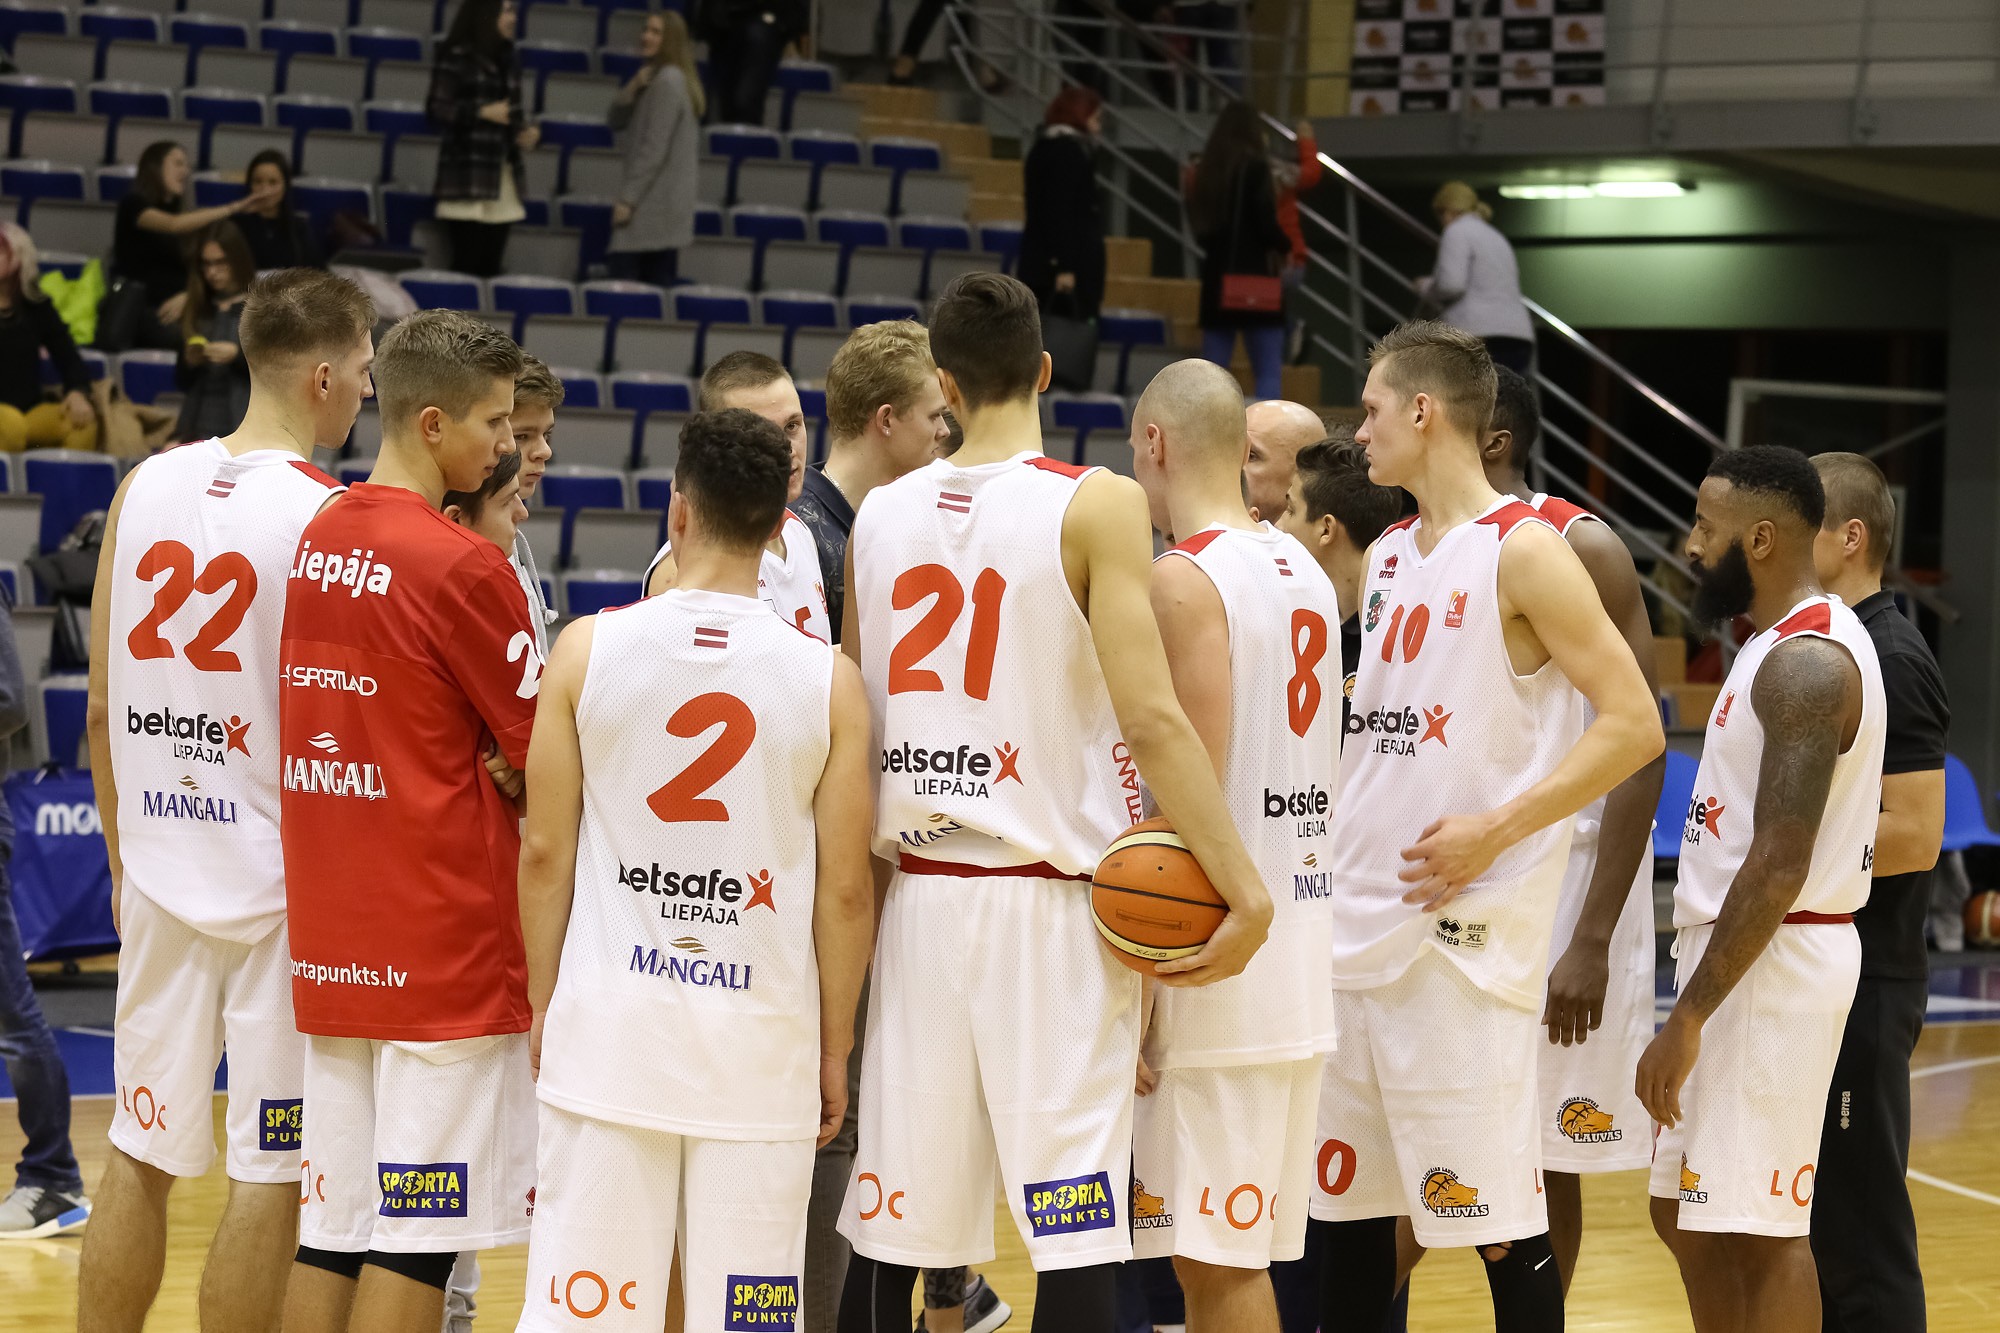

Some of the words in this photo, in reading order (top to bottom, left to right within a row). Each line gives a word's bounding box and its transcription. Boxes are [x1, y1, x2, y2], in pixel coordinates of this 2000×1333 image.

[128, 540, 258, 673] 22
[889, 563, 1007, 701] 21
[1381, 603, 1431, 664] 10
[1287, 608, 1328, 739] 8
[1345, 705, 1419, 736] beafe
[646, 692, 757, 822] 2
[914, 777, 989, 799] LIEPĀJA
[660, 901, 740, 927] LIEPĀJA
[1466, 933, 1482, 942] XL
[291, 959, 408, 988] ortapunkts.lv
[1574, 1129, 1622, 1143] LAUVAS
[382, 1170, 461, 1195] SPORTA
[384, 1197, 461, 1210] PUNKTS
[1032, 1181, 1108, 1212] SPORTA
[1034, 1207, 1111, 1228] PUNKTS
[1437, 1204, 1489, 1218] LAUVAS
[733, 1283, 797, 1309] SPORTA
[732, 1311, 797, 1324] PUNKTS
